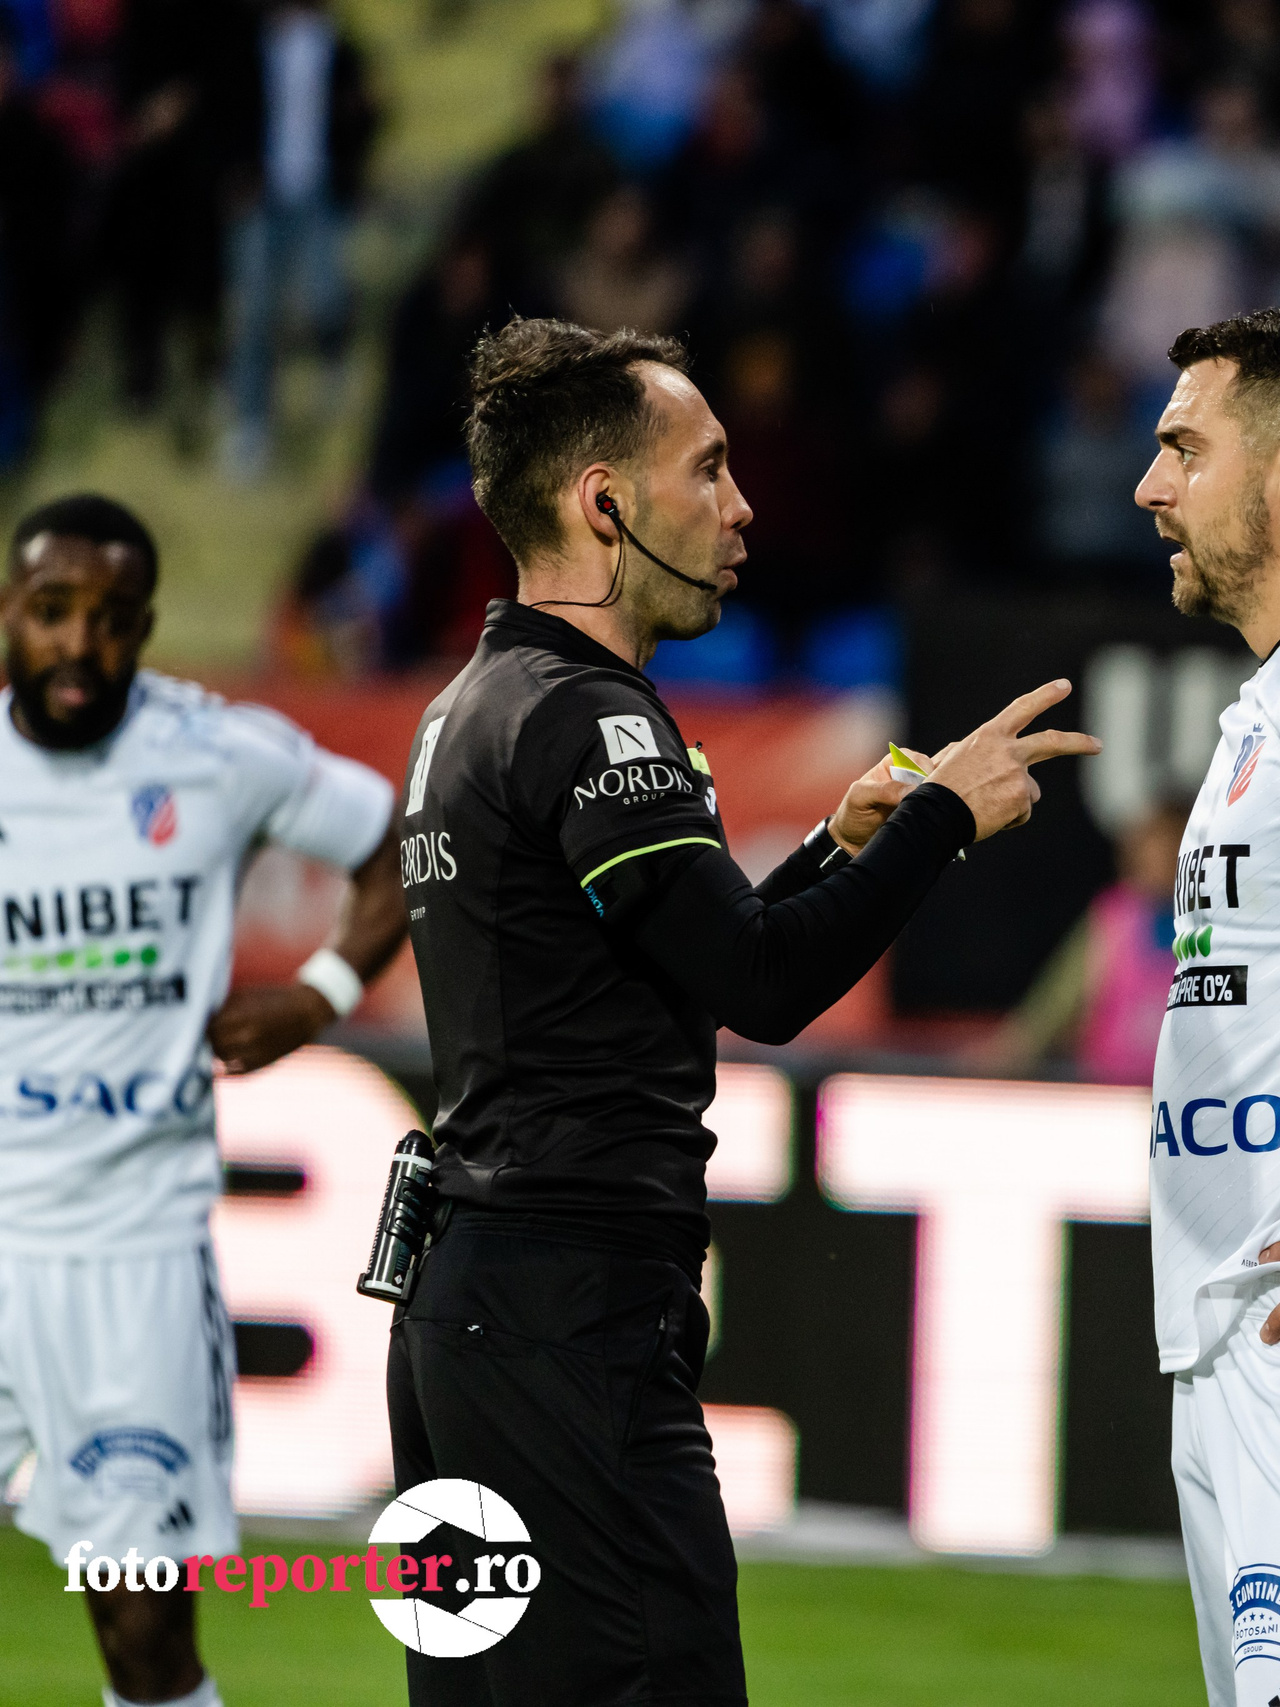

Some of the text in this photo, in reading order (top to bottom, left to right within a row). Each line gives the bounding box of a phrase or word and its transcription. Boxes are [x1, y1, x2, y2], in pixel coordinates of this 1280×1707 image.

[574, 764, 693, 810] NORDIS
[623, 792, 665, 805] GROUP
[410, 906, 426, 921] GROUP
[1203, 975, 1233, 1002] 0%
[2, 1072, 213, 1120] SACO
[1236, 1623, 1279, 1640] BOTOSANI
[1243, 1645, 1263, 1655] GROUP
